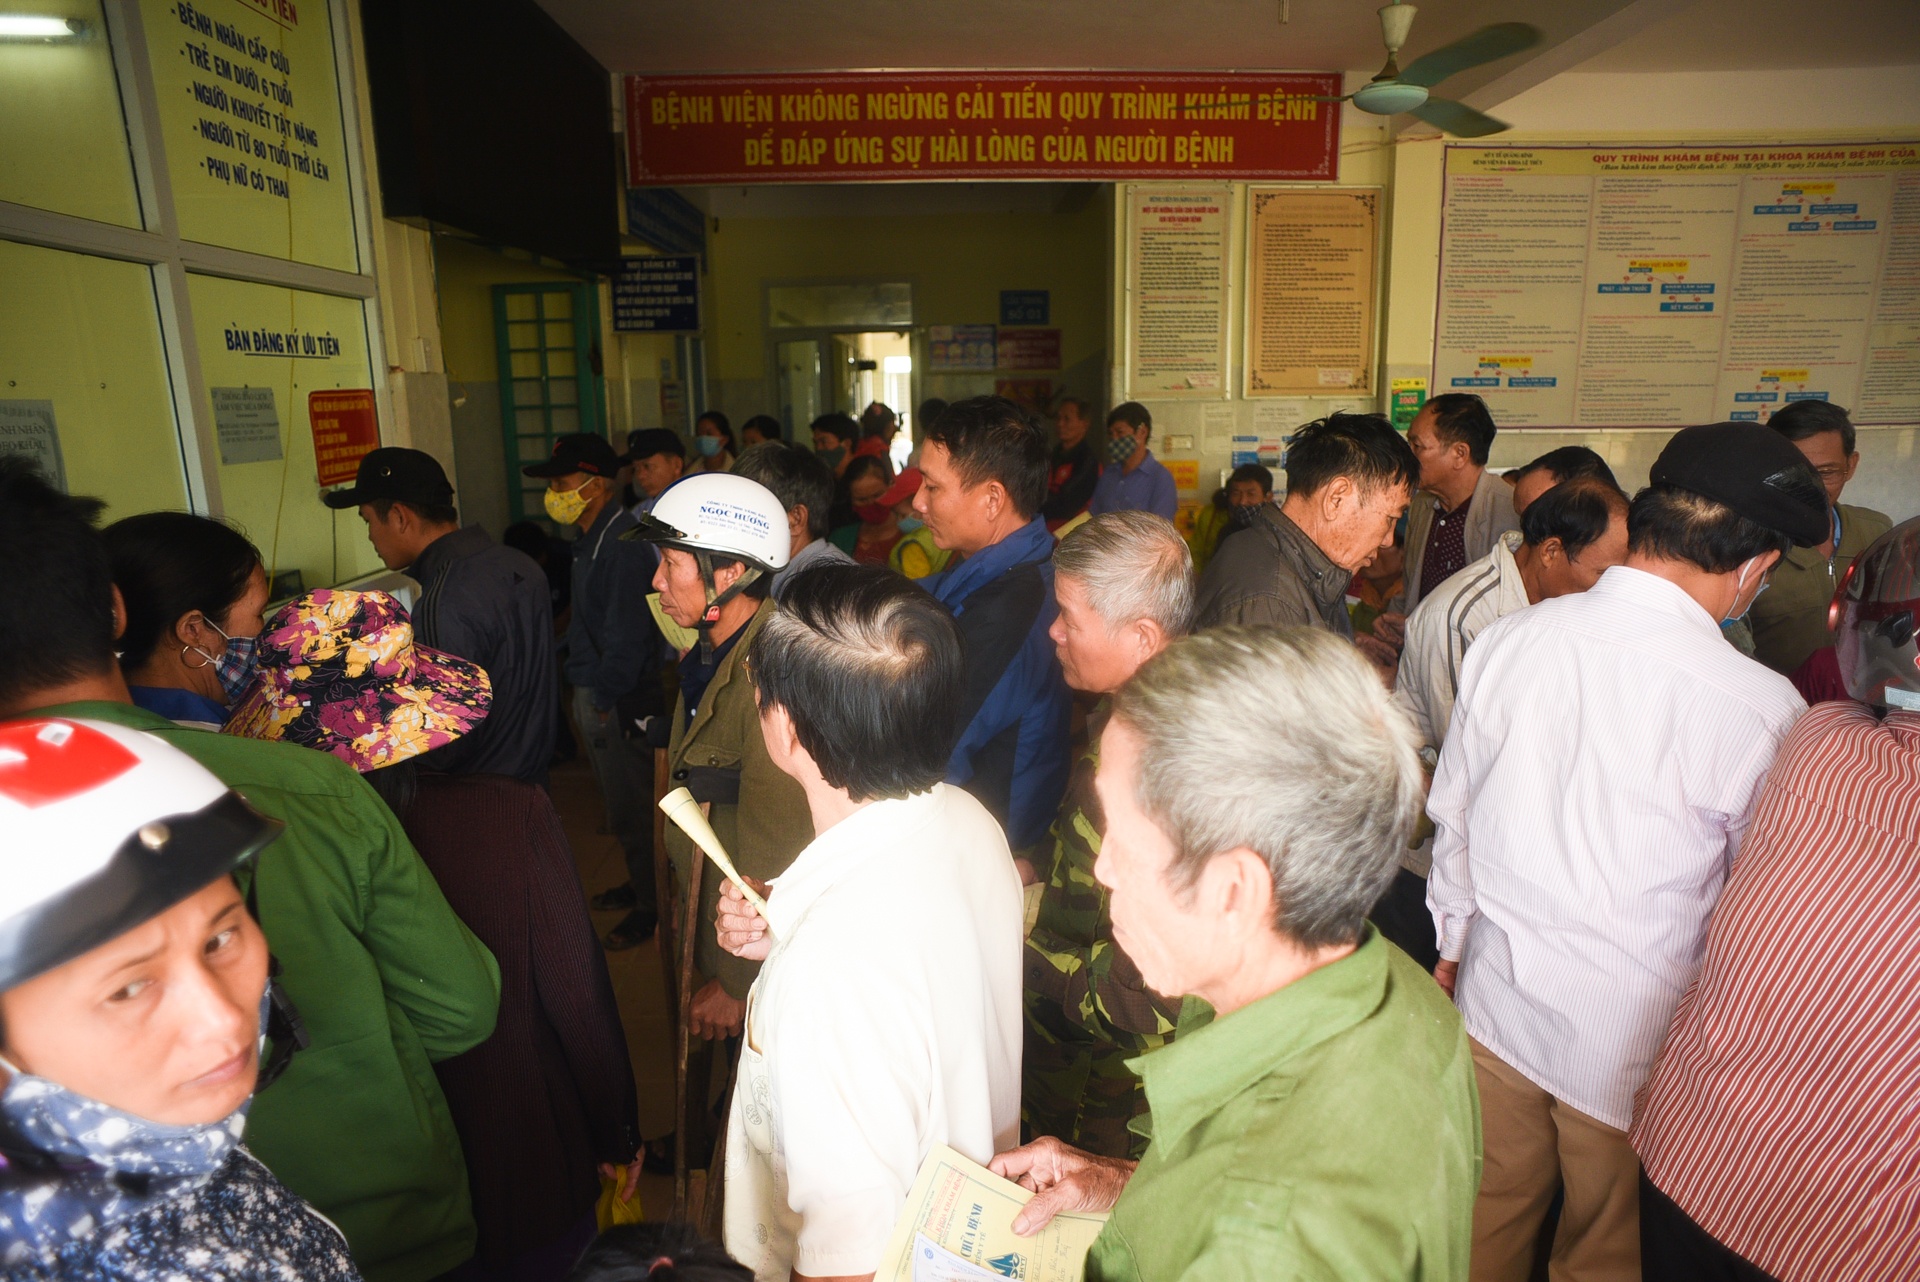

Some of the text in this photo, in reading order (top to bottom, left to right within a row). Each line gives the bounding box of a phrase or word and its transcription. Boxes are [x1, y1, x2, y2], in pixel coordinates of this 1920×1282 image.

[177, 1, 213, 38] BỆNH
[215, 21, 246, 54] NHÂN
[247, 36, 268, 64] CẤP
[270, 49, 290, 75] CỨU
[185, 42, 293, 108] TRẺ EM DƯỚI 6 TUỔI
[193, 80, 318, 147] NGƯỜI KHUYẾT TẬT NẶNG
[652, 82, 1317, 131] BỆNH VIỆN KHÔNG NGỪNG CẢI TIẾN QUY TRÌNH KHÁM BỆNH
[199, 118, 329, 182] NGƯỜI TỪ 80 TUỔI TRỞ LÊN
[745, 127, 1234, 168] ĐỂ ĐÁP ỨNG SỰ HÀI LÒNG CỦA NGƯỜI BỆNH
[1593, 147, 1916, 164] QUY TRÌNH KHÁM BỆNH TẠI KHOA KHÁM BỆNH CỦA
[207, 156, 290, 199] PHỤ NỮ CÓ THAI
[224, 322, 340, 356] BÀN ĐĂNG KÝ ƯU TIÊN
[699, 506, 732, 518] NGỌC
[734, 512, 770, 529] HƯƠNG
[935, 1214, 947, 1233] KHOA
[944, 1191, 956, 1213] KHÁM
[953, 1173, 964, 1191] BỆNH
[960, 1202, 983, 1258] CHỮA BỆNH
